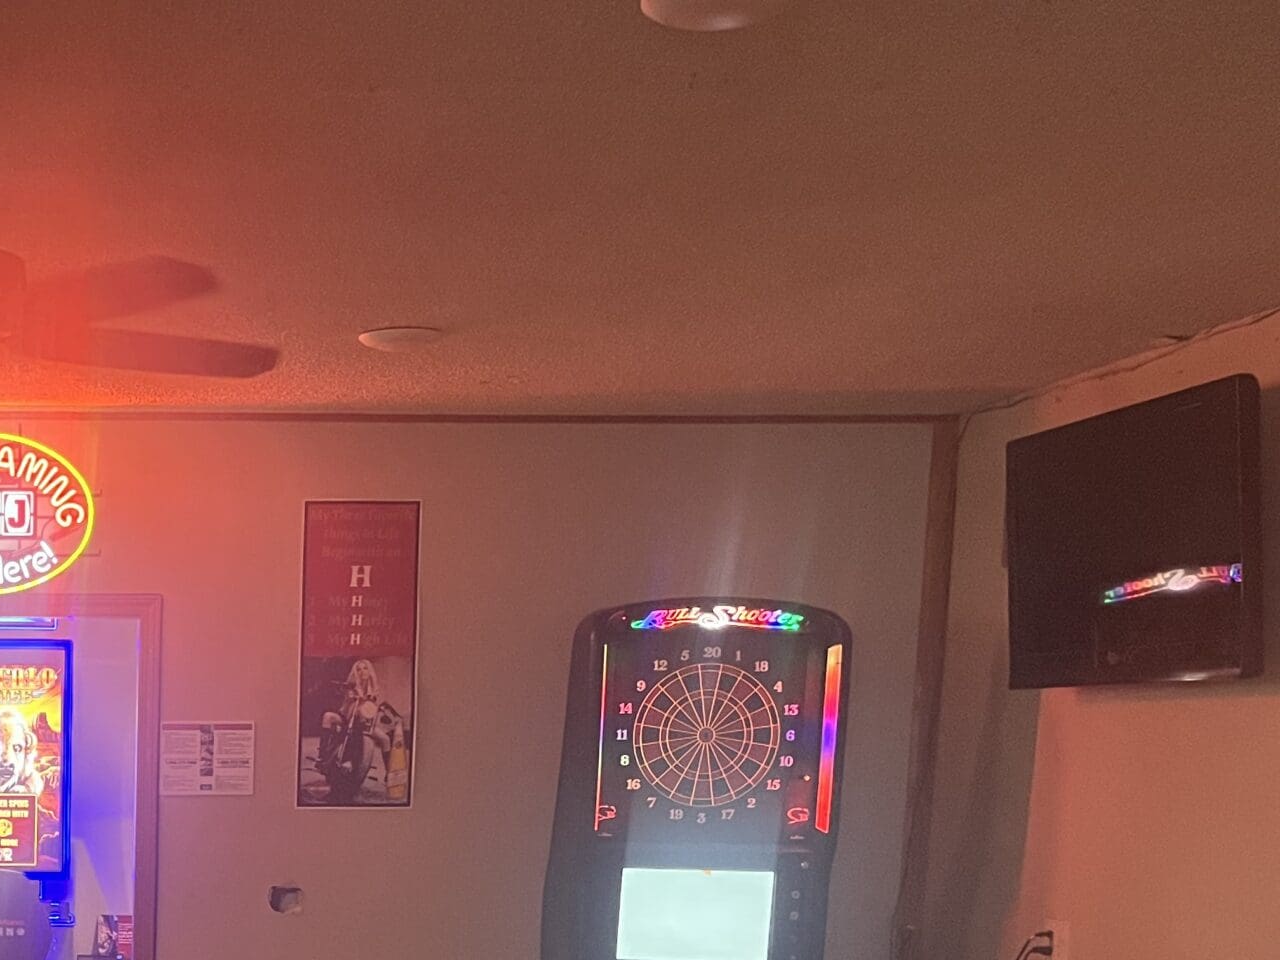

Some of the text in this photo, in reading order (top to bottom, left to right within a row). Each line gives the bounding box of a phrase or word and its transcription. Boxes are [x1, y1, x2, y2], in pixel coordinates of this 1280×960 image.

[350, 565, 372, 587] H
[681, 650, 689, 660] 5
[703, 647, 721, 657] 20
[736, 651, 740, 661] 1
[654, 660, 667, 670] 12
[755, 661, 768, 672] 18
[637, 680, 646, 691] 9
[774, 681, 782, 692] 4
[619, 703, 632, 714] 14
[784, 704, 799, 715] 13
[617, 729, 627, 740] 11
[786, 730, 795, 741] 6
[621, 755, 629, 766] 8
[780, 756, 793, 767] 10
[627, 779, 640, 789] 16
[767, 779, 780, 790] 15
[647, 797, 656, 808] 7
[747, 798, 755, 808] 2
[670, 809, 683, 819] 19
[697, 813, 706, 823] 3
[722, 809, 735, 819] 17
